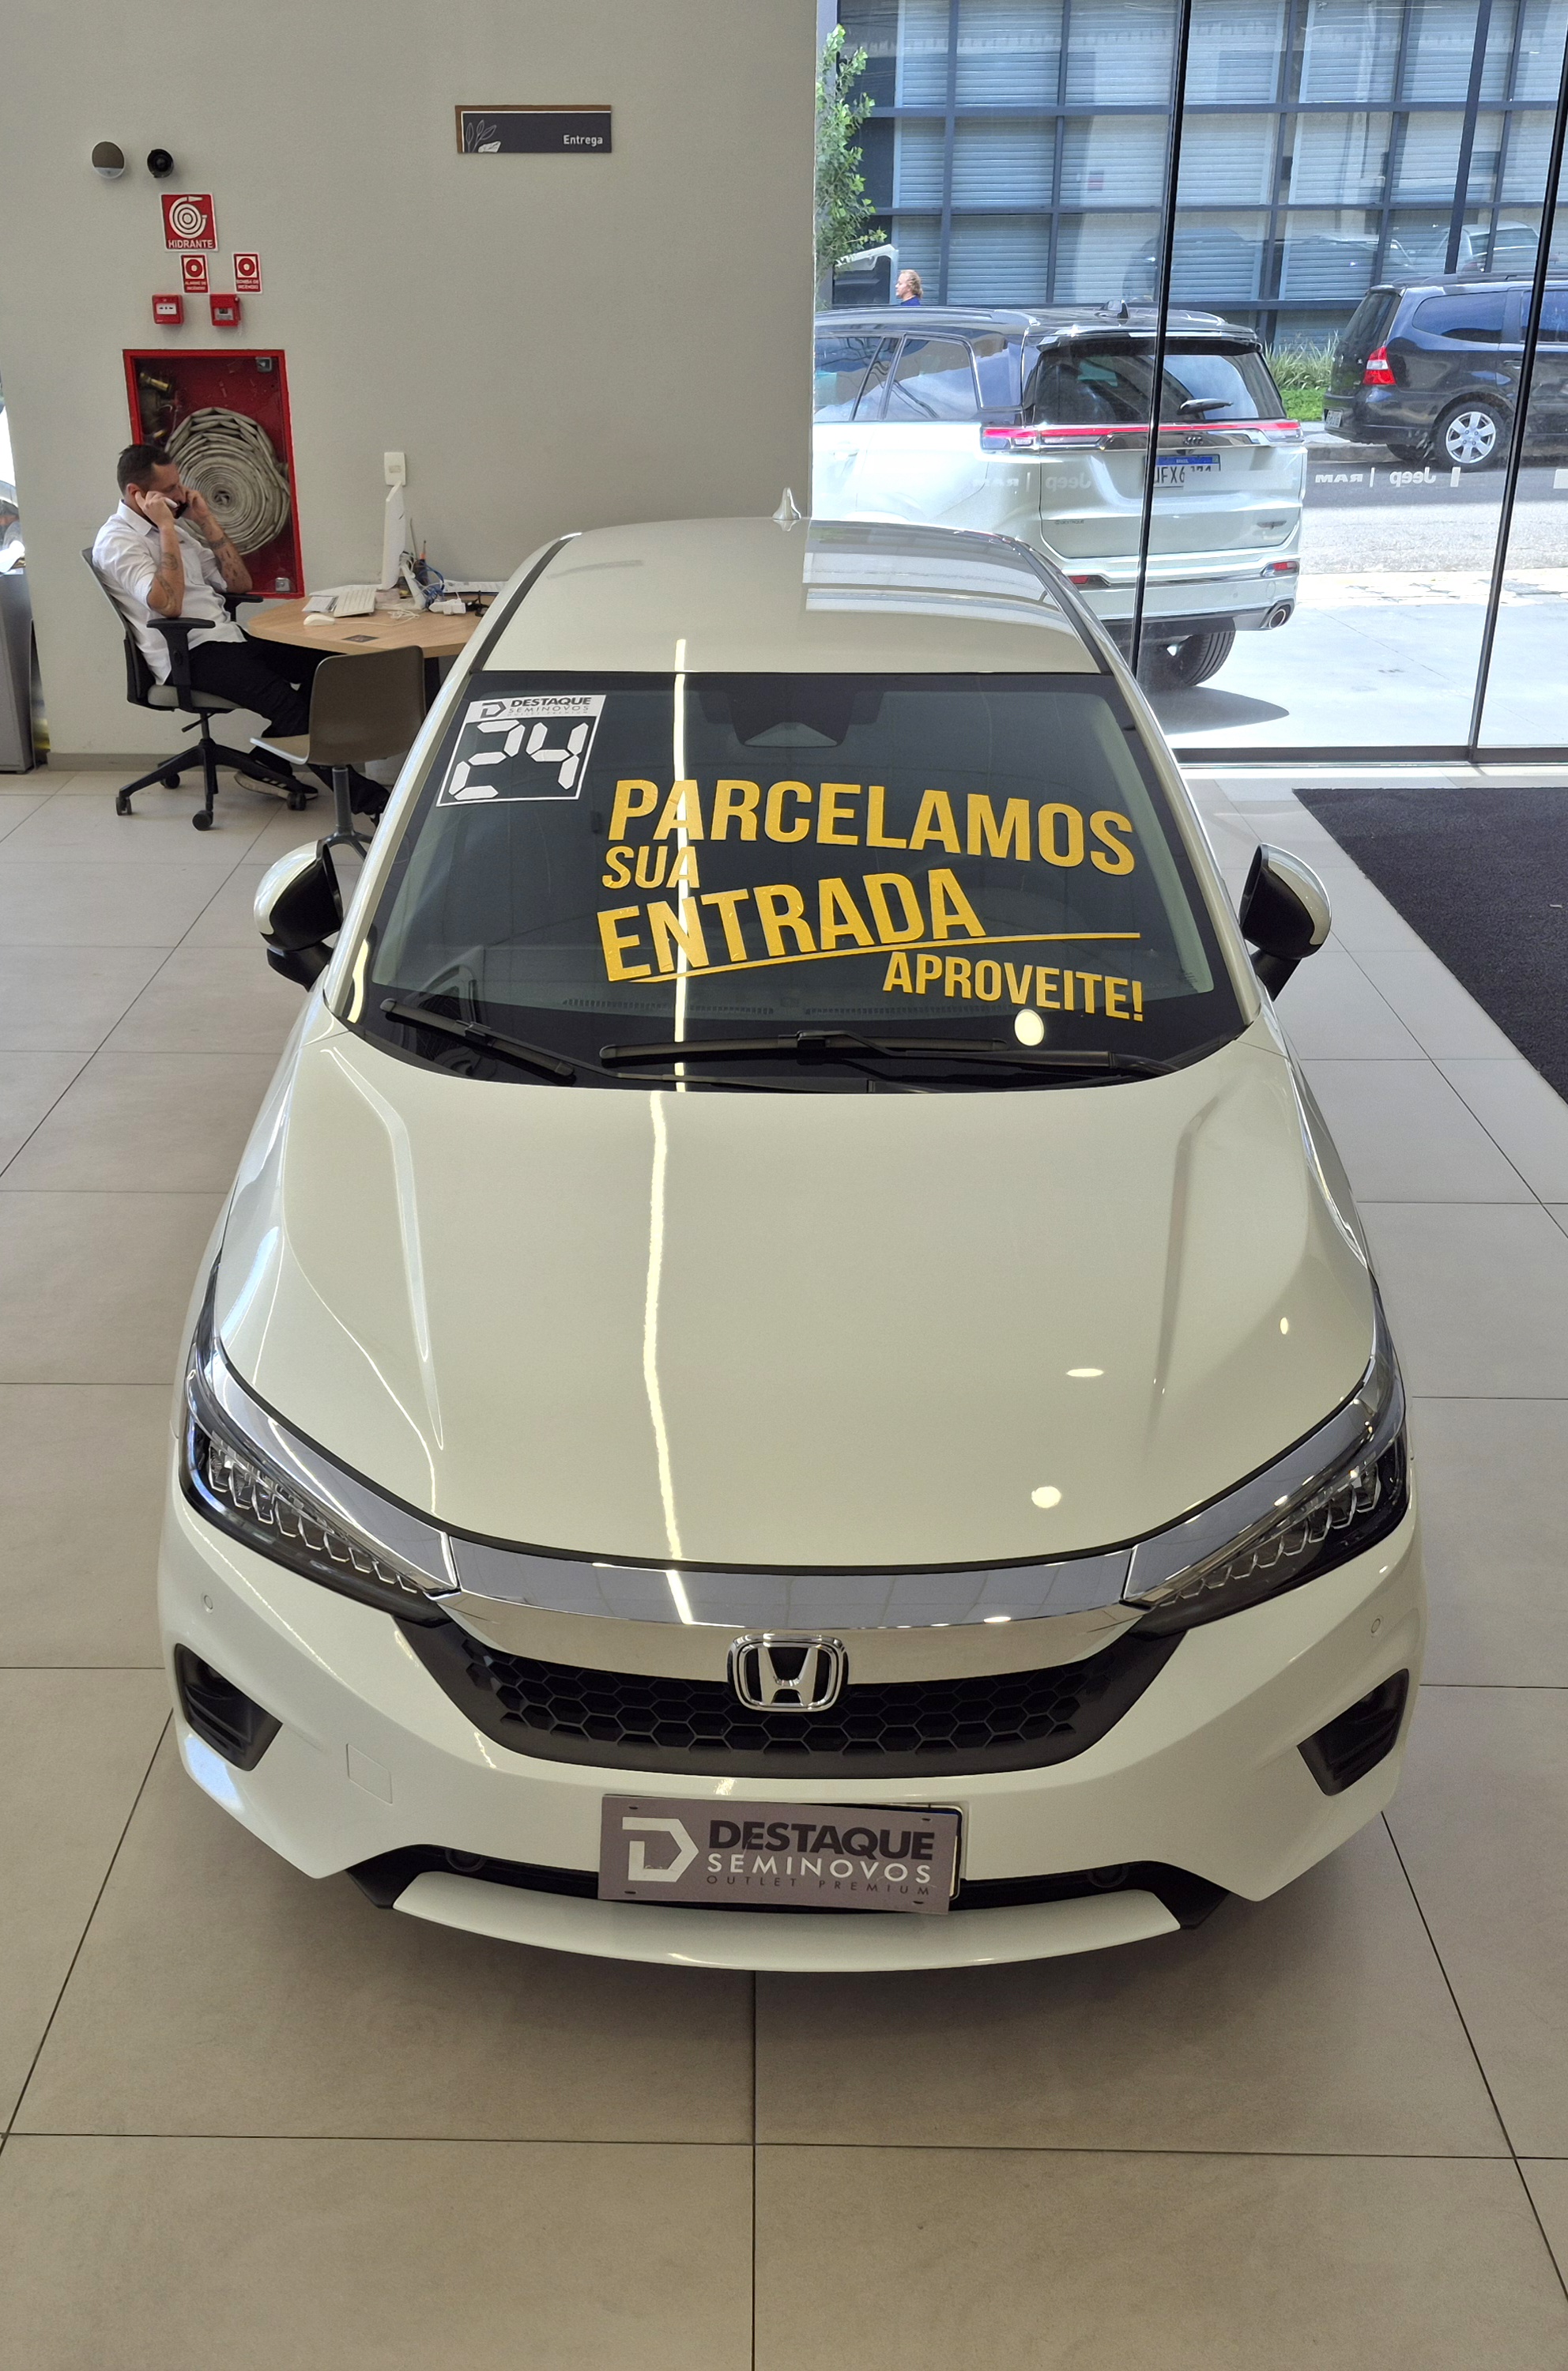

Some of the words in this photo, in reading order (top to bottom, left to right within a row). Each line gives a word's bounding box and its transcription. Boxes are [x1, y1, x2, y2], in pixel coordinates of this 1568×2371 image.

[563, 134, 603, 146] Entrega
[168, 239, 213, 249] HIDRANTE
[508, 705, 589, 714] SEMINOVOS
[511, 697, 592, 707] DESTAQUE
[448, 719, 589, 801] 24
[607, 779, 1136, 875] PARCELAMOS
[601, 846, 700, 888] SUA
[597, 868, 986, 982] ENTRADA
[882, 952, 1144, 1022] APROVEITE!
[709, 1820, 935, 1860] DESTAQUE
[707, 1853, 931, 1884] SEMINOVOS
[707, 1875, 797, 1887] OUTLET
[819, 1879, 930, 1895] PREMIUM
